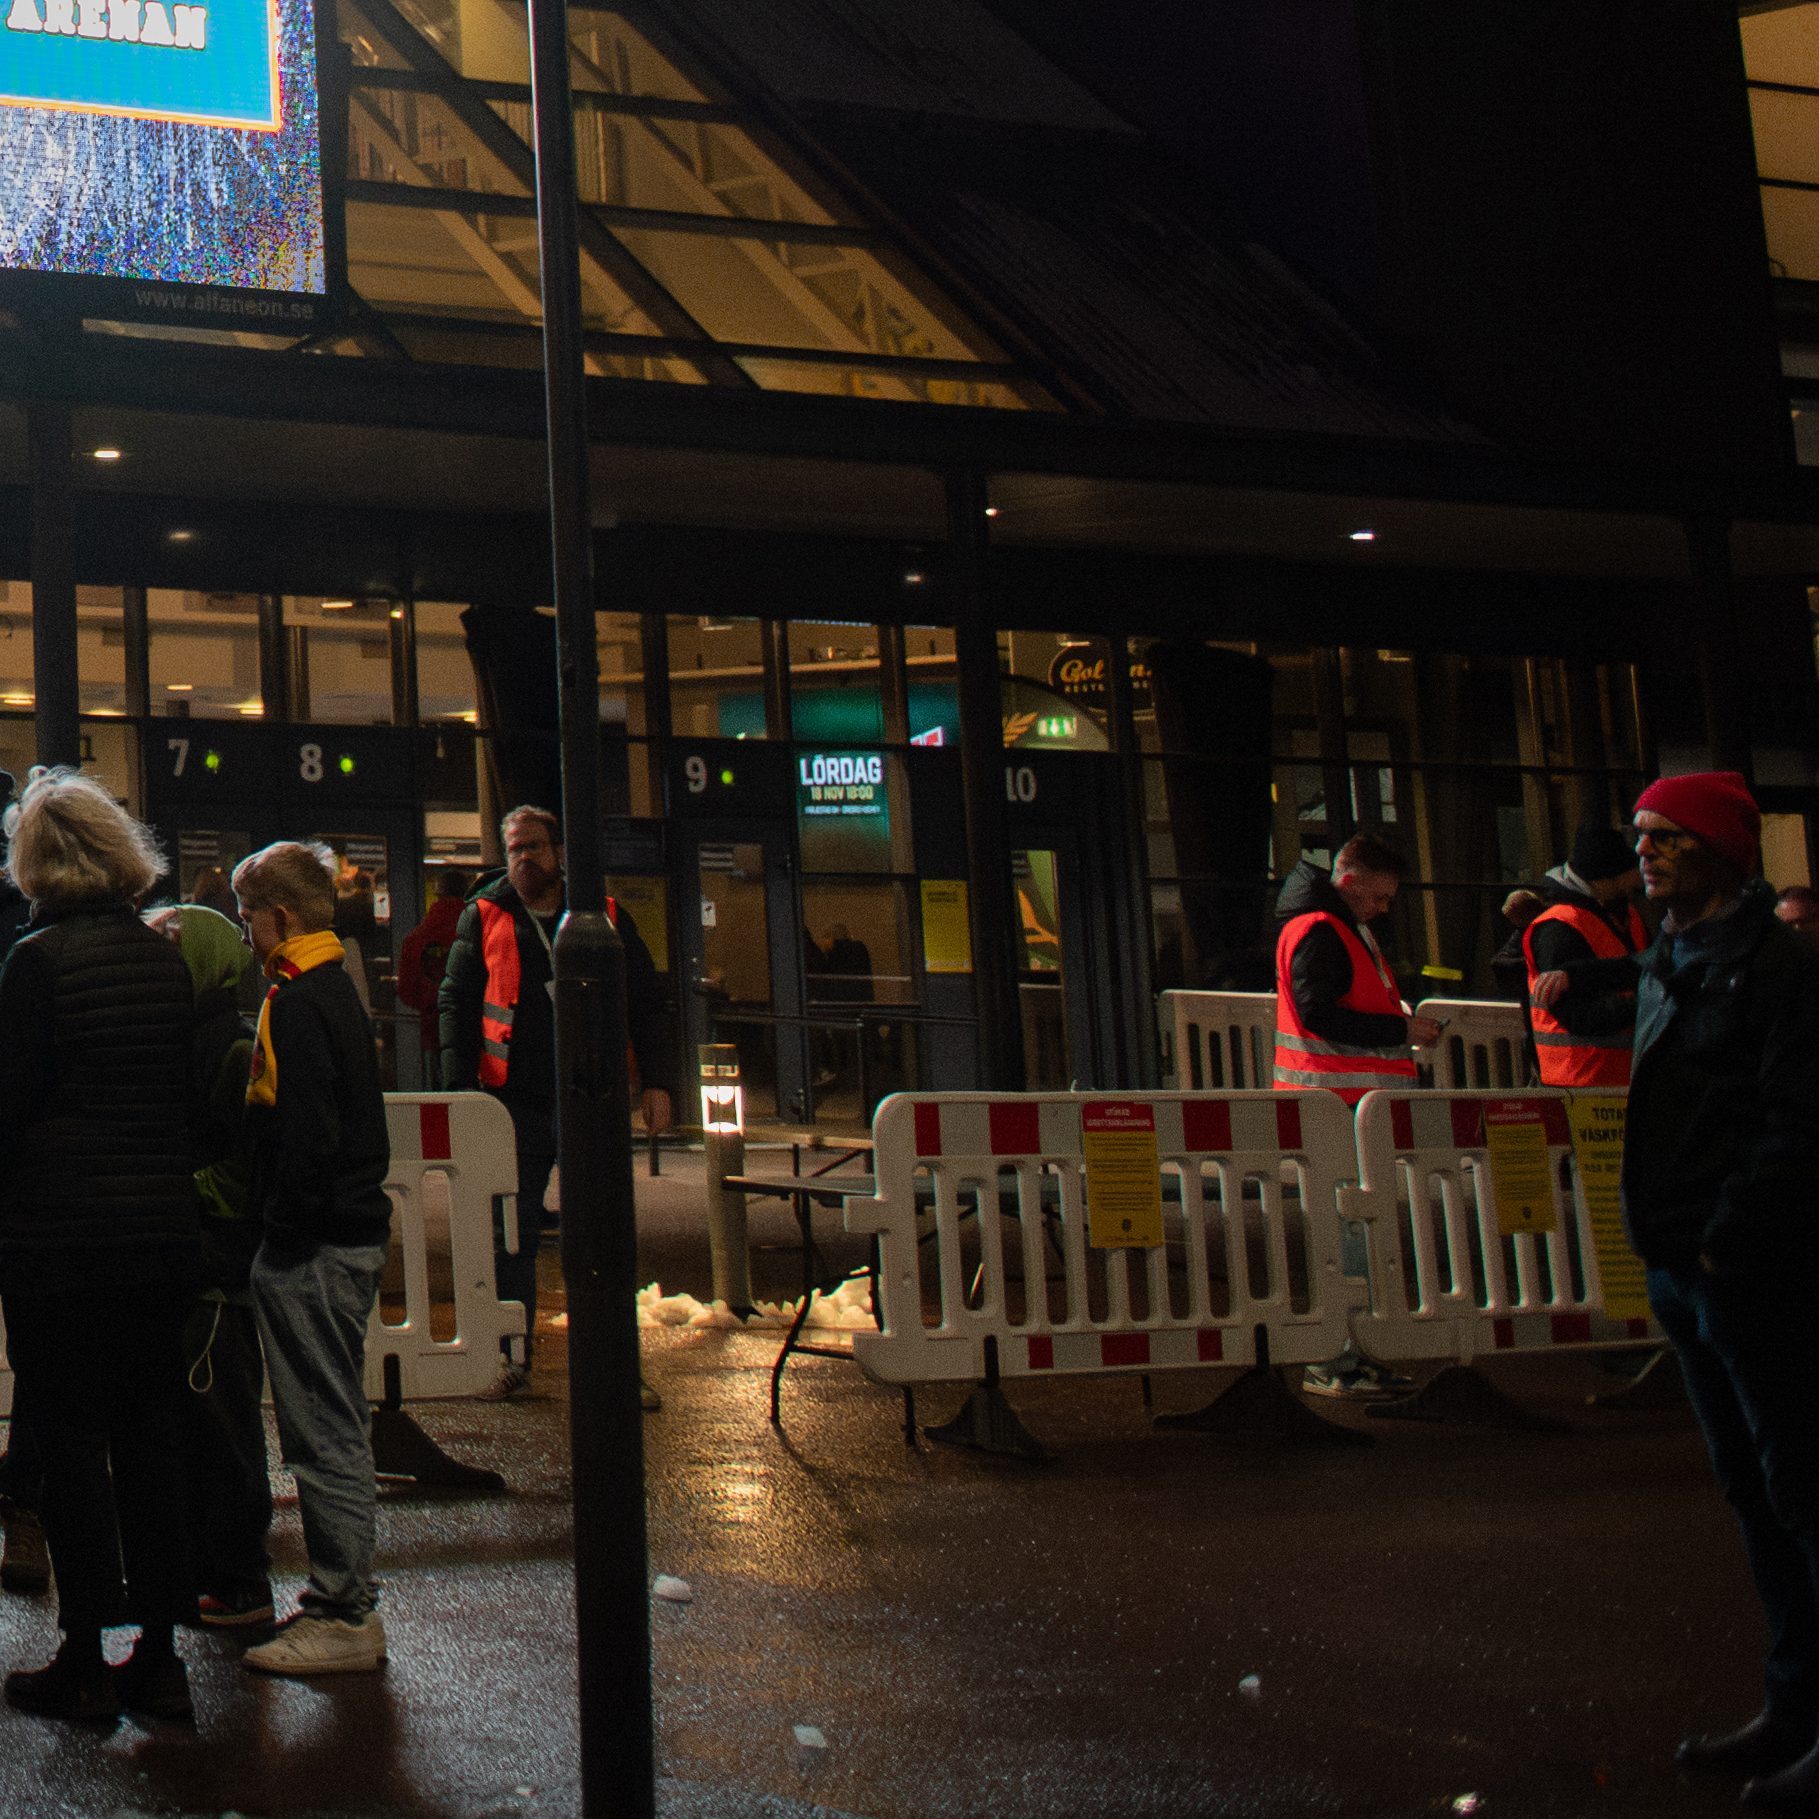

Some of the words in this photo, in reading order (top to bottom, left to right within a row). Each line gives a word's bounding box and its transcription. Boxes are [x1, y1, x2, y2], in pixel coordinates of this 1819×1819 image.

[168, 738, 190, 777] 7
[300, 743, 324, 782] 8
[685, 756, 708, 794] 9
[799, 753, 883, 786] LÖRDAG
[1005, 766, 1038, 802] 10
